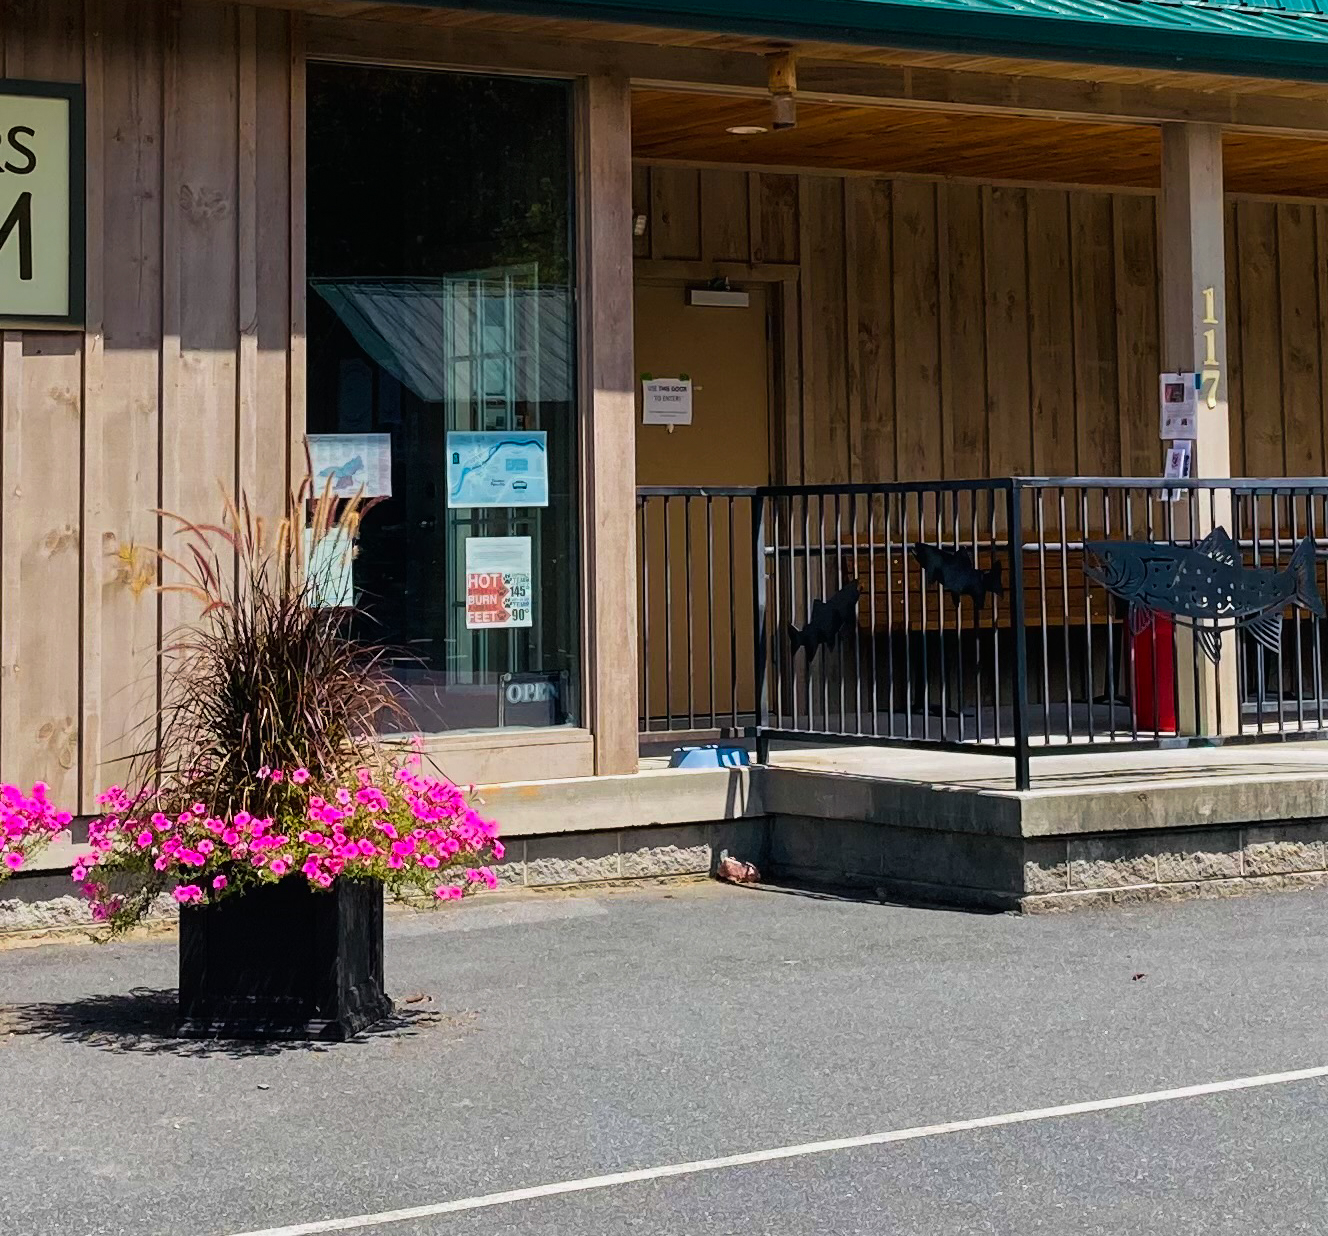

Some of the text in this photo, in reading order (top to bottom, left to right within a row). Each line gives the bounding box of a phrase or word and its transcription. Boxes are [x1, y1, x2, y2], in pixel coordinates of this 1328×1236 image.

[468, 573, 500, 589] HOT
[468, 594, 498, 605] BURN
[468, 611, 497, 623] FEET
